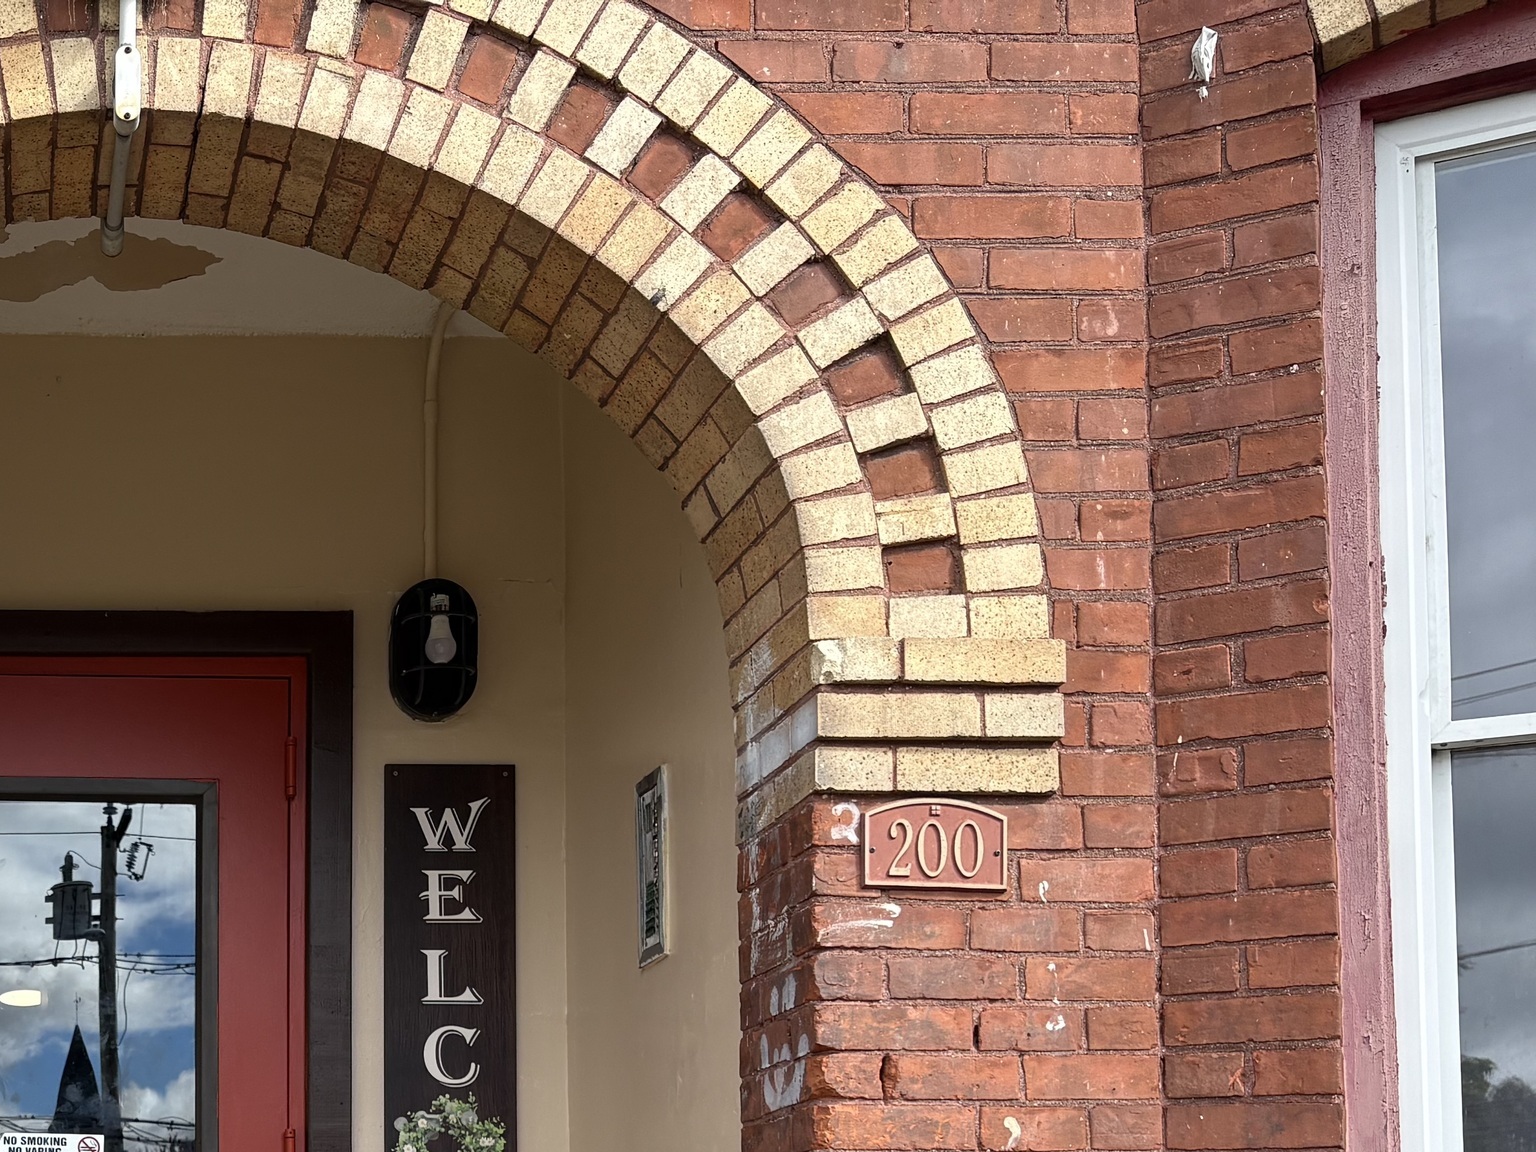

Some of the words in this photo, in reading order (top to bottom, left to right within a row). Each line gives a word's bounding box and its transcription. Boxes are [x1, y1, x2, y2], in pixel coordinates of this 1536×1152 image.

[888, 818, 985, 878] 200
[3, 1136, 17, 1145] NO
[20, 1136, 67, 1146] SMOKING
